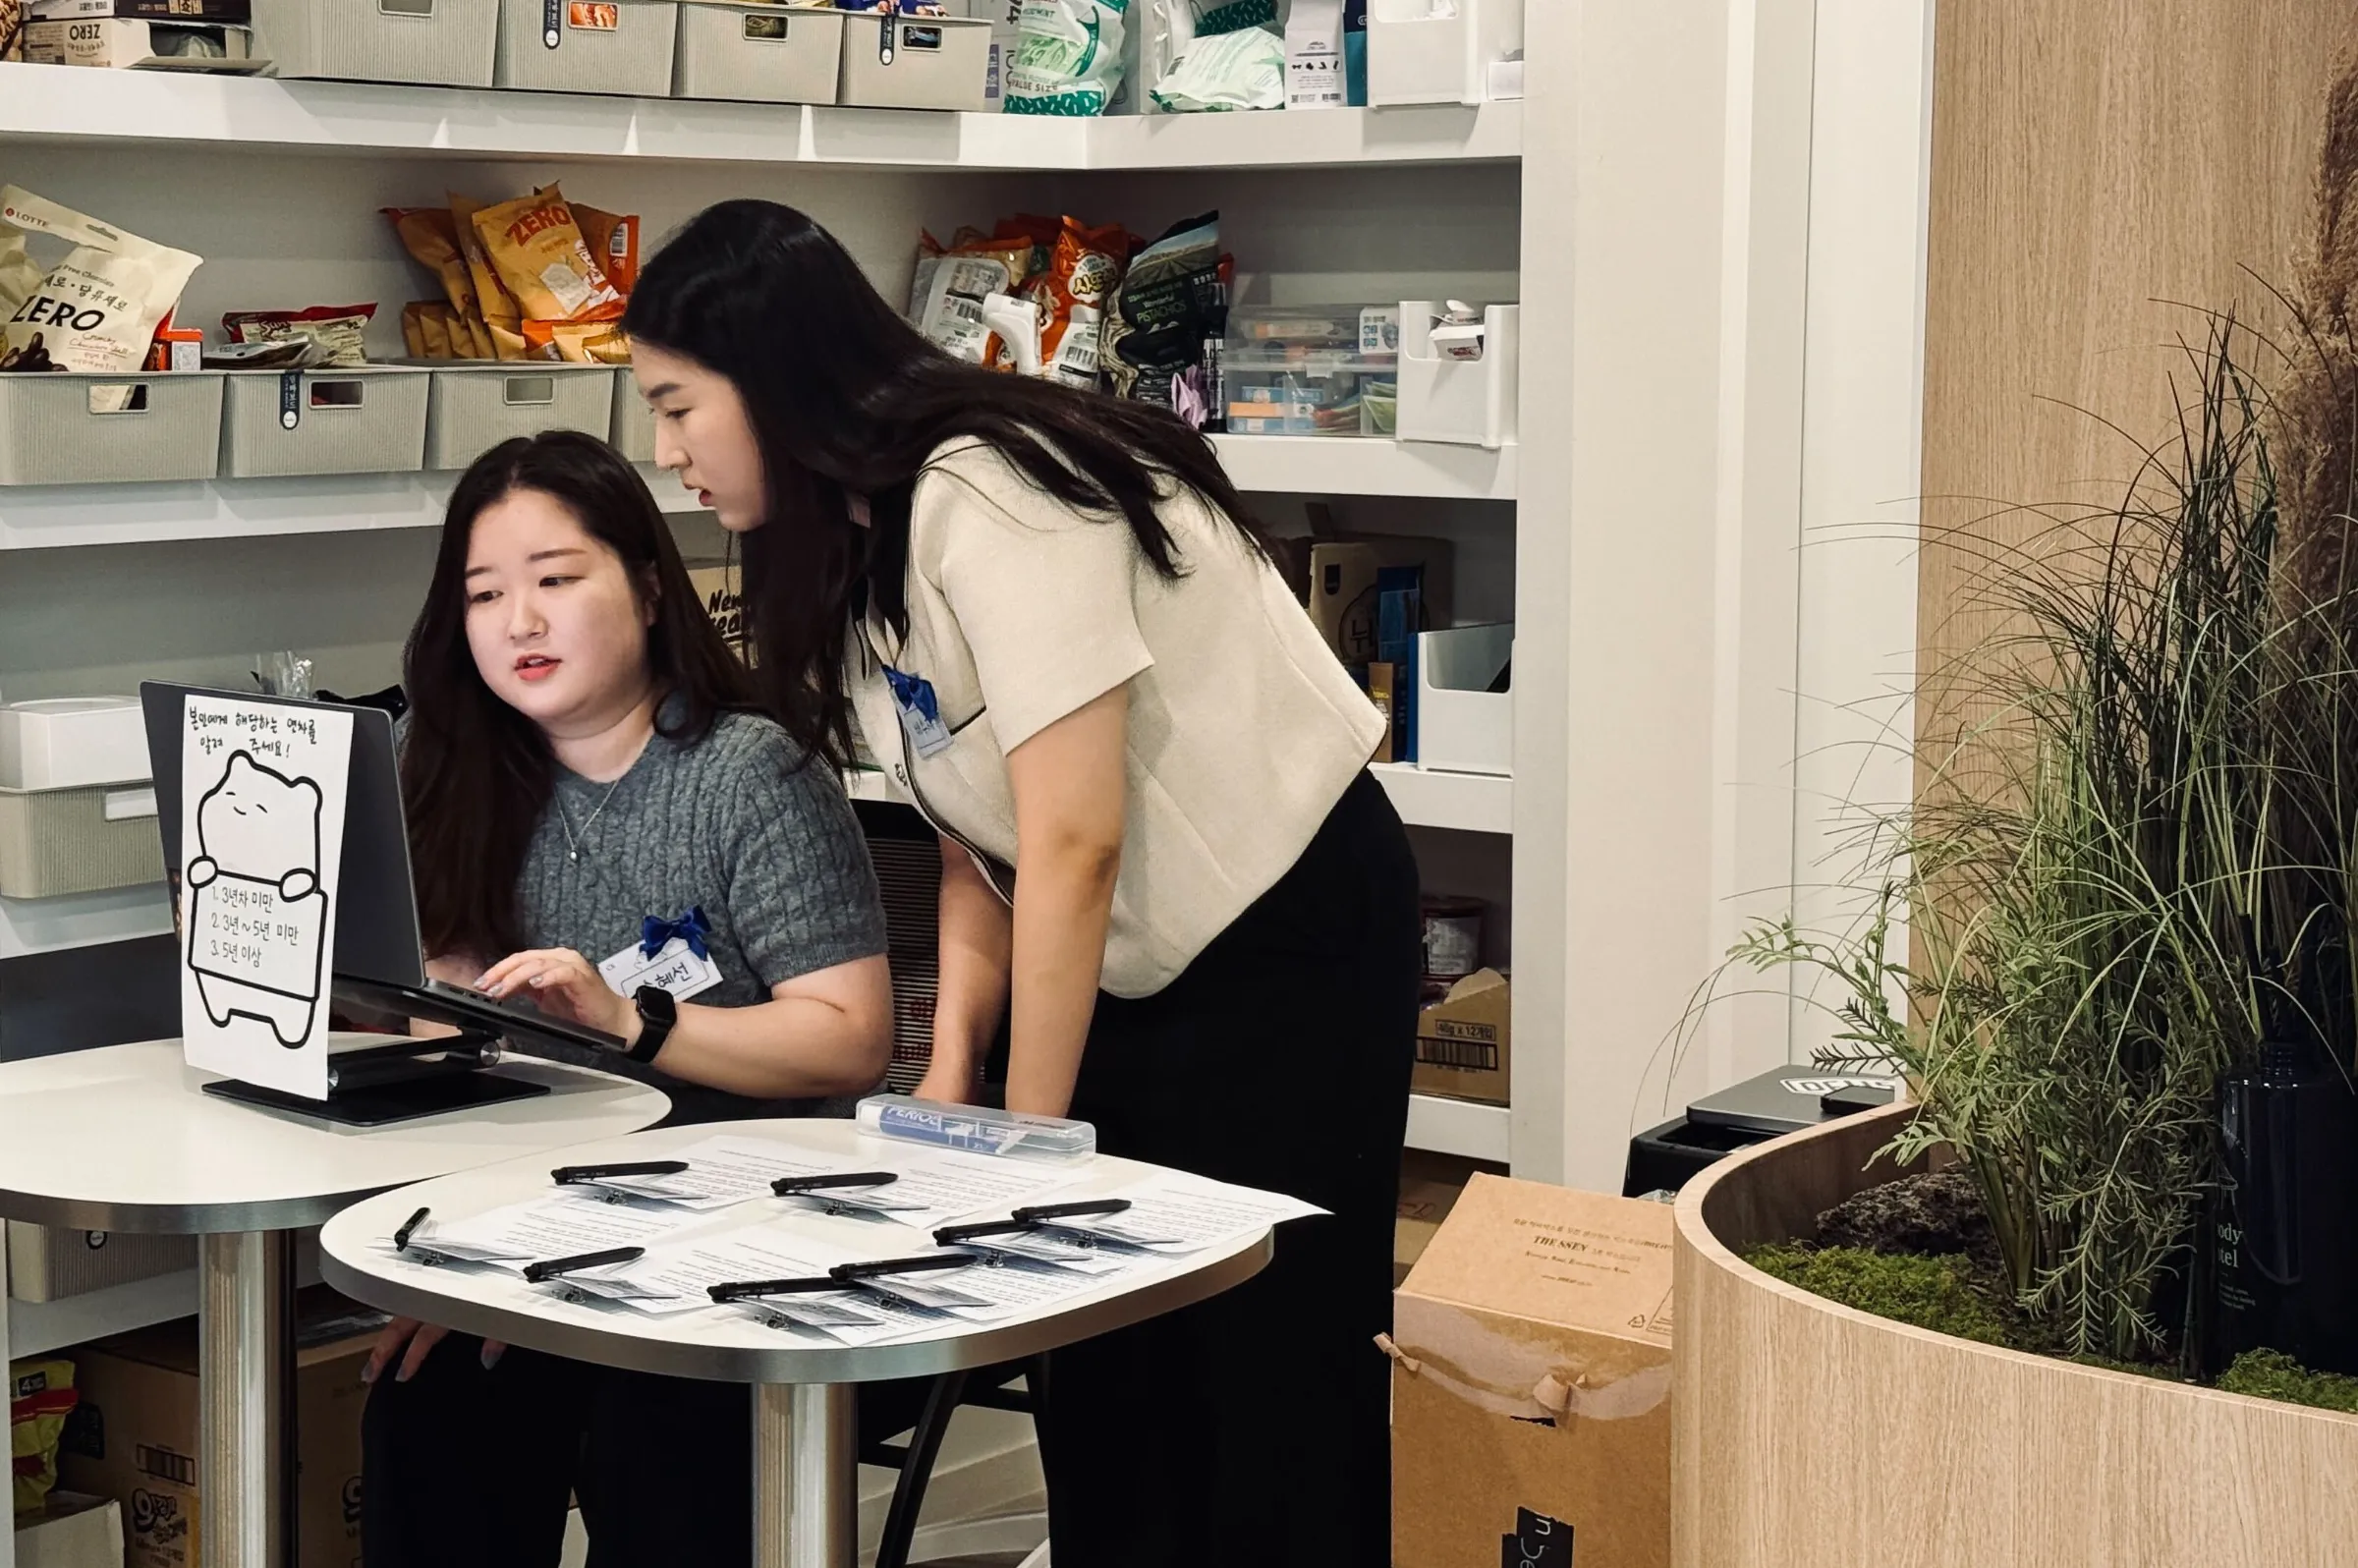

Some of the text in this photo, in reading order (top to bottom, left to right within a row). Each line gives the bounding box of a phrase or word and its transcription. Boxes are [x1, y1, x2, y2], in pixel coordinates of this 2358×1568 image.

[70, 24, 101, 41] ZERO
[16, 211, 48, 228] LOTTE
[504, 204, 571, 247] ZERO
[190, 705, 317, 746] 본인에게 해당하는 연차를
[199, 734, 291, 758] 알려 주세요!
[252, 891, 274, 914] 미만
[276, 923, 300, 947] 미만
[241, 944, 262, 969] 이상
[2216, 1222, 2244, 1246] ody
